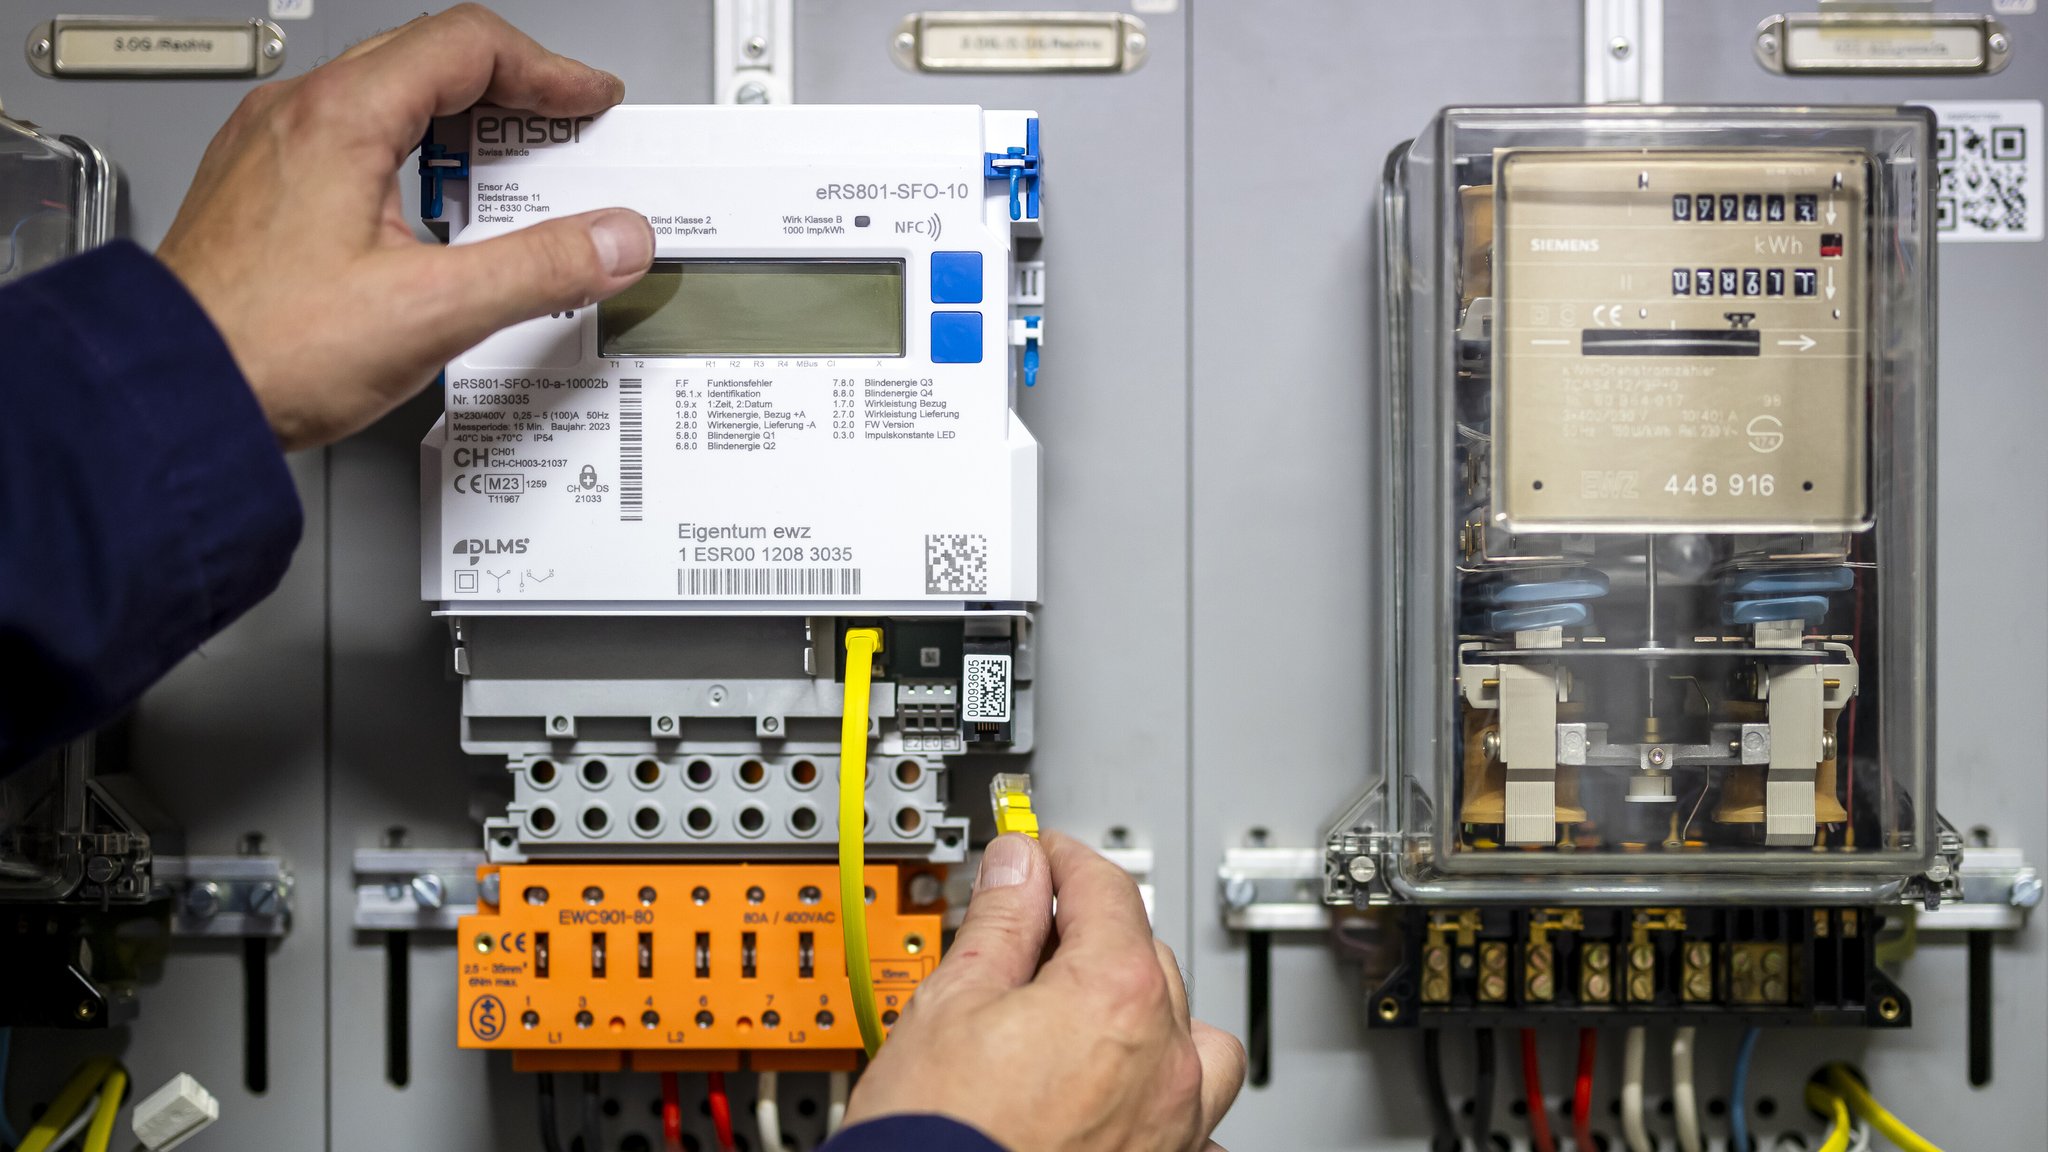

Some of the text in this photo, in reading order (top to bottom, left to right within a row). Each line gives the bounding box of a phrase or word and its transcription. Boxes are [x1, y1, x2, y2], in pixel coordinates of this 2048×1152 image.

[477, 116, 593, 144] ensor
[478, 148, 530, 157] Swiss Made
[478, 183, 519, 191] Ensor AG
[816, 183, 969, 200] eRS801-SFO-10
[478, 194, 541, 202] Riedstrasse 11
[478, 204, 492, 212] CH
[500, 204, 522, 212] 6330
[523, 204, 550, 212] Cham
[478, 215, 514, 223] Schweiz
[651, 216, 711, 224] Blind Klasse 2
[782, 216, 843, 224] Wirk Klasse B
[675, 226, 717, 236] Imp/kvarh
[806, 226, 845, 236] Imp/kWh
[895, 221, 925, 234] NFC
[1530, 238, 1600, 252] SIEMENS
[1755, 236, 1803, 254] kWh
[453, 378, 609, 389] eRS801-SFO-10-a-10002b
[707, 379, 773, 387] Funktionsfehler
[833, 379, 933, 388] 7.8.0 Blindenergie Q3
[675, 390, 761, 398] 96.1.x Identifikation
[865, 389, 917, 399] Blindenergie
[920, 389, 933, 397] Q4
[453, 395, 529, 405] Nr. 12083035
[708, 401, 734, 409] 1:Zeit,
[833, 400, 947, 409] 1.7.0 Wirkleistung Bezug
[513, 412, 532, 421] 0,25
[543, 412, 548, 420] 5
[550, 412, 579, 421] (100)A
[586, 412, 609, 420] 50Hz
[676, 411, 806, 420] 1.8.0 Wirkenergie, Bezug +A
[865, 410, 917, 420] Wirkleistung
[919, 410, 960, 420] Lieferung
[453, 423, 510, 433] Messperiode:
[527, 423, 544, 431] Min.
[551, 423, 586, 432] Baujahr:
[707, 422, 761, 431] Wirkenergie,
[763, 421, 803, 431] Lieferung
[833, 421, 914, 429] 0.2.0 FW Version
[481, 434, 494, 442] bis
[534, 434, 553, 442] IP54
[676, 432, 775, 441] 5.8.0 Blindenergie Q1
[865, 431, 934, 440] Impulskonstante
[937, 431, 956, 439] LED
[491, 448, 515, 456] CH01
[707, 442, 760, 452] Blindenergie
[763, 442, 776, 450] Q2
[453, 448, 489, 468] CH
[491, 459, 568, 468] CH-CH003-21037
[489, 477, 519, 490] M23
[526, 480, 547, 488] 1259
[1663, 473, 1718, 496] 448
[1728, 473, 1776, 496] 916
[567, 485, 609, 493] CH DS
[488, 495, 520, 503] T11967
[575, 495, 602, 503] 21033
[678, 523, 811, 541] Eigentum ewz
[679, 547, 852, 561] 1 ESR00 1208 3035
[968, 660, 979, 717] 00093605
[559, 909, 654, 925] EWC901-80
[743, 912, 768, 924] 80A
[784, 912, 835, 924] 400VAC
[645, 996, 654, 1007] 4
[766, 995, 775, 1006] 7
[549, 1031, 806, 1043] L1 L2 L3
